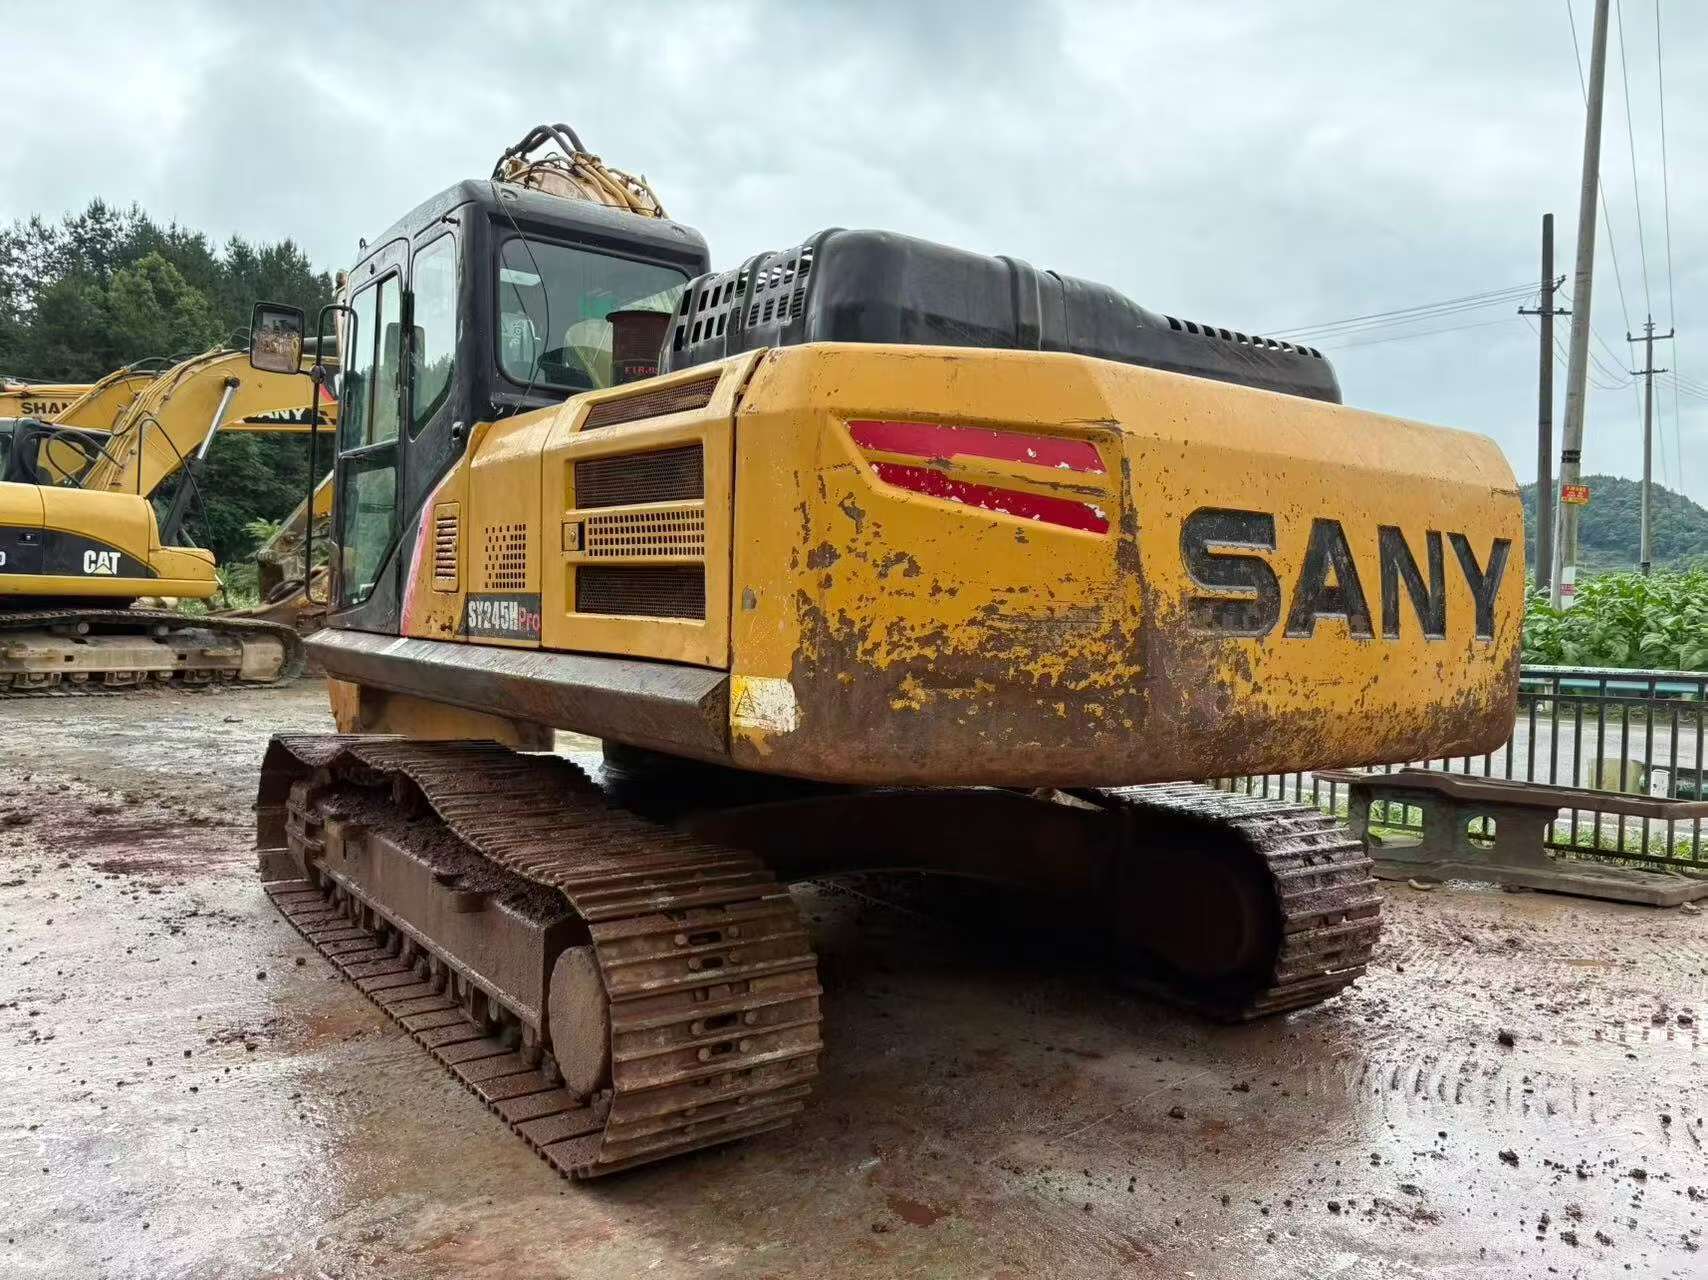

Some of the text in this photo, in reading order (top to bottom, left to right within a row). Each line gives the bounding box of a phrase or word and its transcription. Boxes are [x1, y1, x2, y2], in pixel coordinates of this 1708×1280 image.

[83, 550, 121, 575] CAT
[1179, 505, 1512, 640] SANY
[468, 600, 540, 632] SY245H Pro
